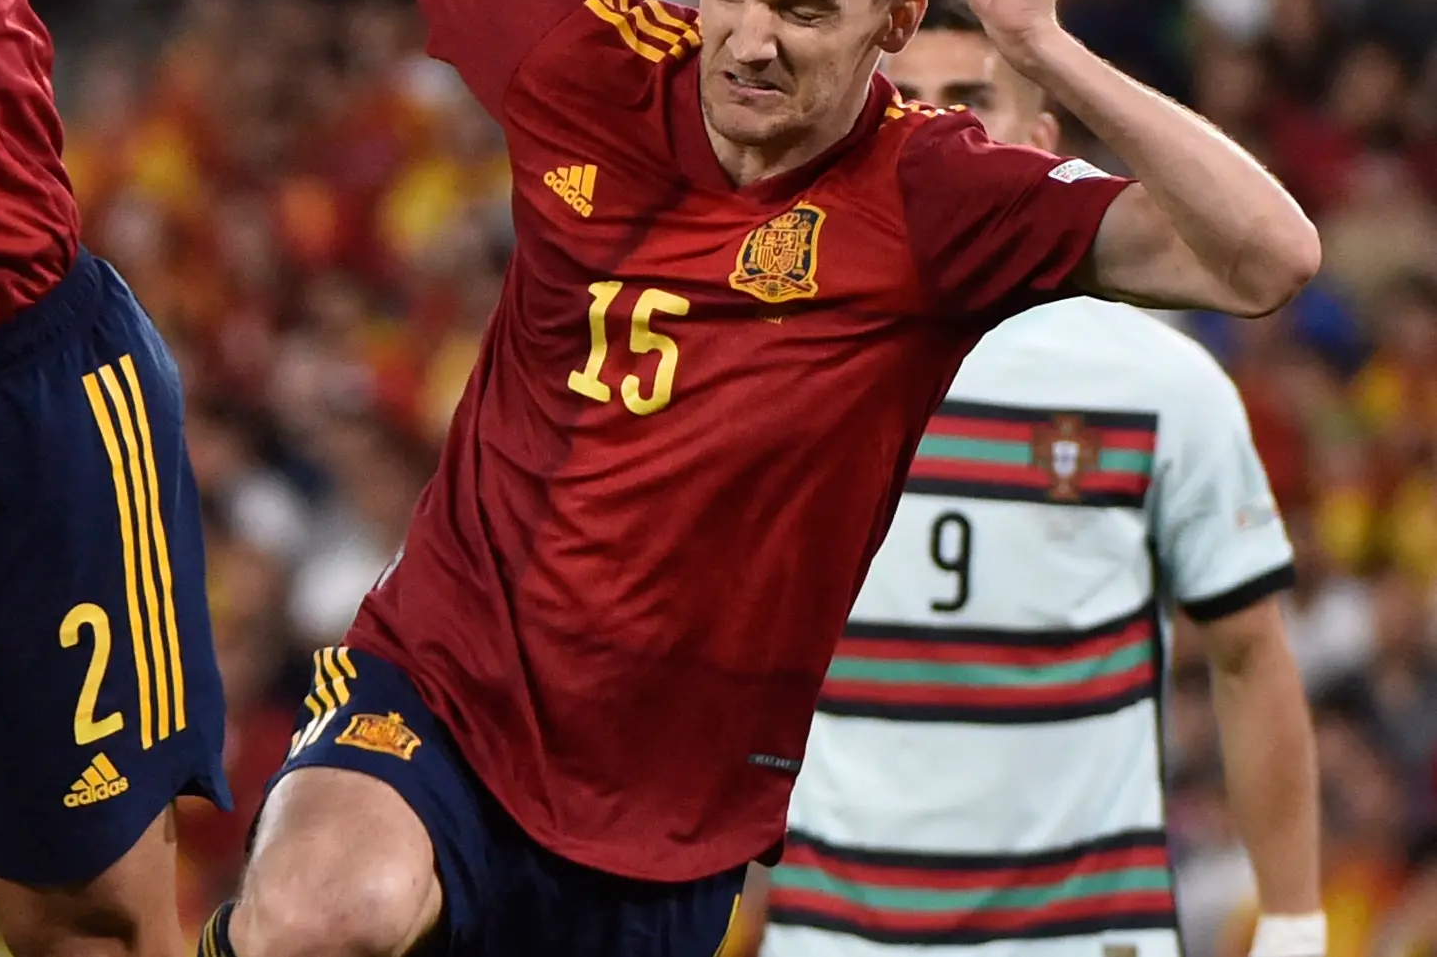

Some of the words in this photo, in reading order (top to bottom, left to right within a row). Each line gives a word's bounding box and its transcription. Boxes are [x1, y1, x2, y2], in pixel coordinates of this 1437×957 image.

[544, 171, 593, 217] adidas
[568, 281, 690, 415] 15
[929, 510, 971, 613] 9
[59, 603, 124, 745] 2
[64, 777, 129, 807] adidas
